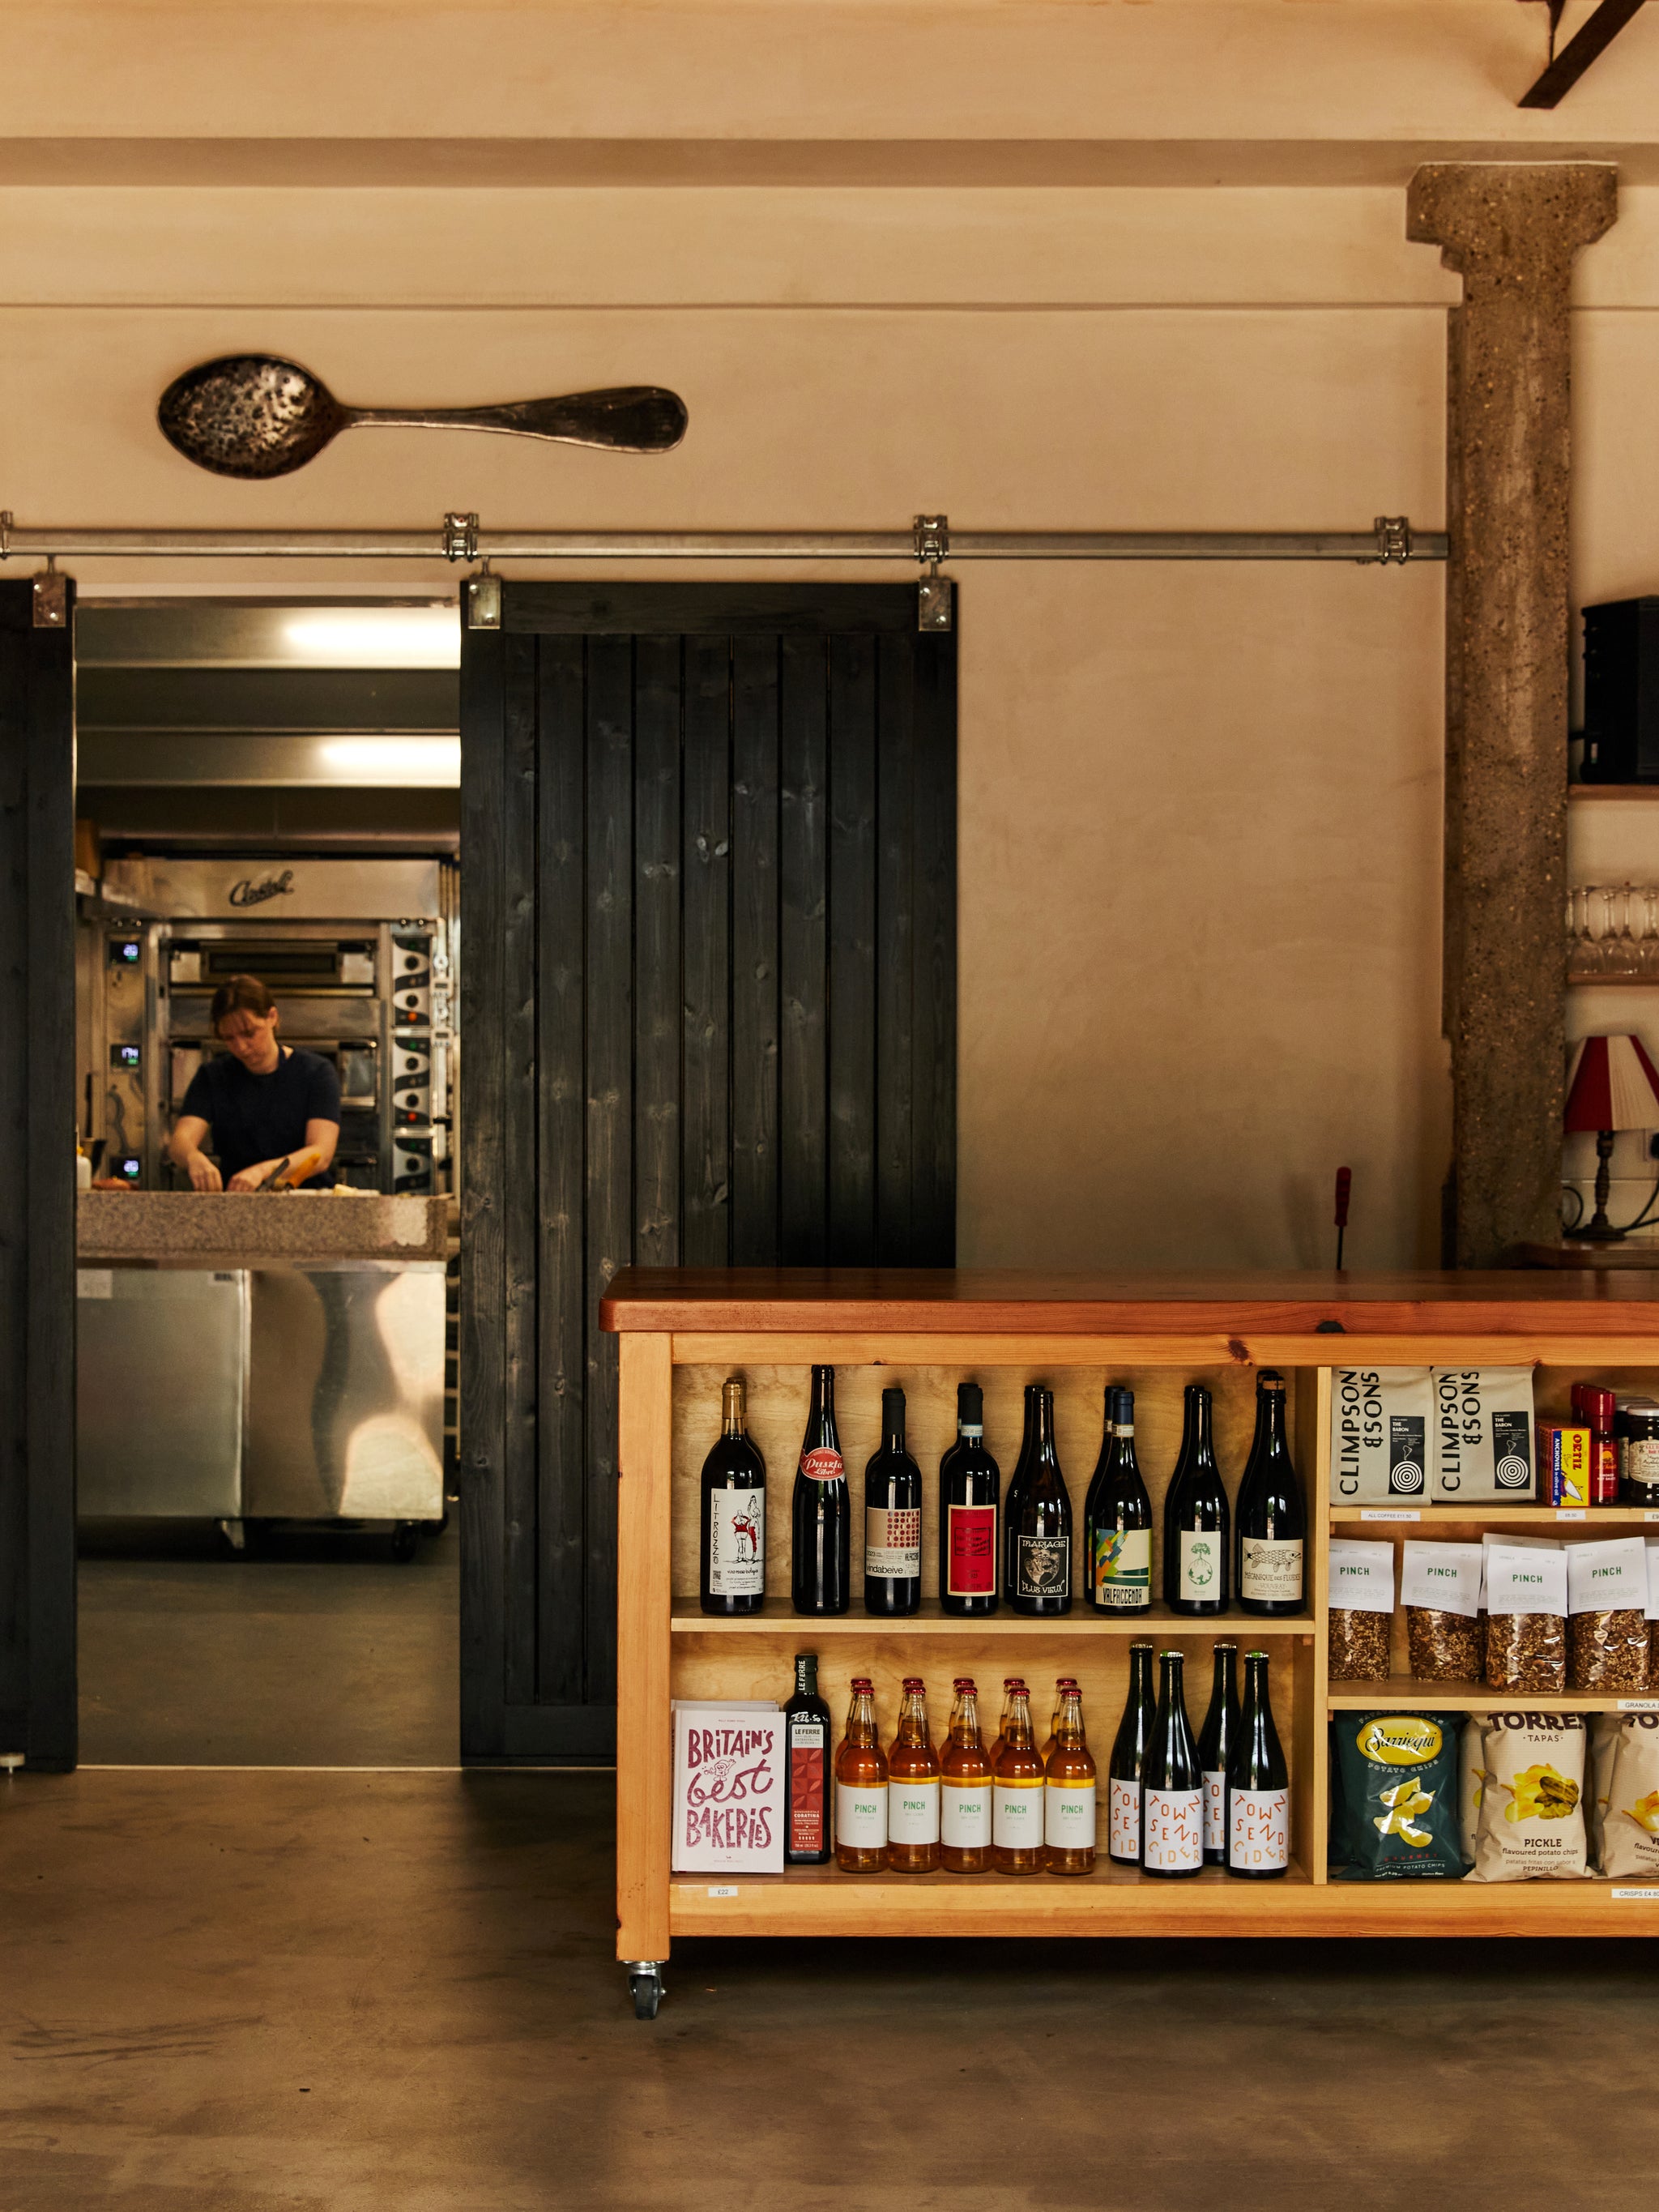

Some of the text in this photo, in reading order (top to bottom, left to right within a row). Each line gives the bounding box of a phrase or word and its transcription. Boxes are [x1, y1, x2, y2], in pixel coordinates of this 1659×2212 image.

[1361, 1372, 1383, 1433] SONS
[1461, 1371, 1482, 1431] SONS
[1339, 1370, 1360, 1495] CLIMPSON
[1439, 1373, 1461, 1492] CLIMPSON
[1572, 1433, 1582, 1470] ORTIZ
[804, 1458, 842, 1471] Puszta
[712, 1493, 720, 1565] LITROZZO
[1022, 1539, 1066, 1549] MARIAGE
[1340, 1566, 1370, 1575] PINCH
[1427, 1568, 1457, 1578] PINCH
[1592, 1566, 1622, 1578] PINCH
[1512, 1574, 1543, 1583] PINCH
[1021, 1579, 1065, 1594] PLUS VIEUX
[798, 1682, 805, 1691] LE
[1367, 1759, 1439, 1774] POTATO CHIPS
[687, 1758, 774, 1808] best
[855, 1804, 876, 1813] PINCH
[903, 1800, 925, 1810] PINCH
[959, 1804, 981, 1813] PINCH
[1004, 1804, 1026, 1813] PINCH
[1060, 1804, 1083, 1813] PINCH
[1149, 1795, 1201, 1821] TOWN
[1235, 1794, 1286, 1821] TOWN
[686, 1806, 773, 1849] BAKERIES
[1149, 1818, 1199, 1846] SEND
[1235, 1818, 1284, 1846] SEND
[1524, 1838, 1562, 1847] PICKLE
[1148, 1841, 1201, 1865] CIDER
[1234, 1840, 1286, 1865] CIDER
